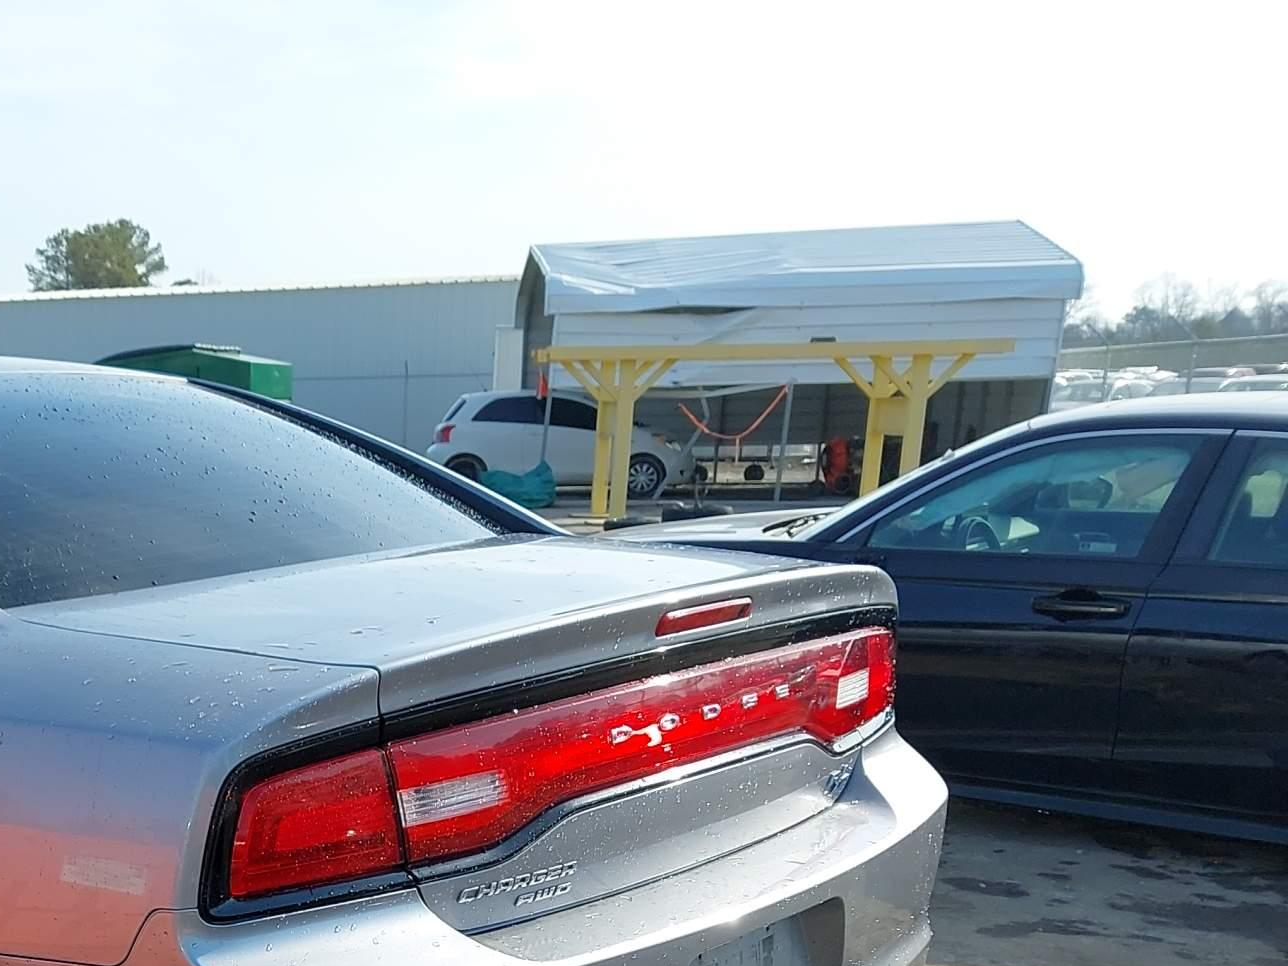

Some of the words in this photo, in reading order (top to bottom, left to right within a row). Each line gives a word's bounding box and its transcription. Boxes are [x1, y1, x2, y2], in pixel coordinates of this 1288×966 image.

[609, 683, 791, 744] DODGE
[456, 860, 578, 904] CHARGER
[513, 881, 572, 907] AWD
